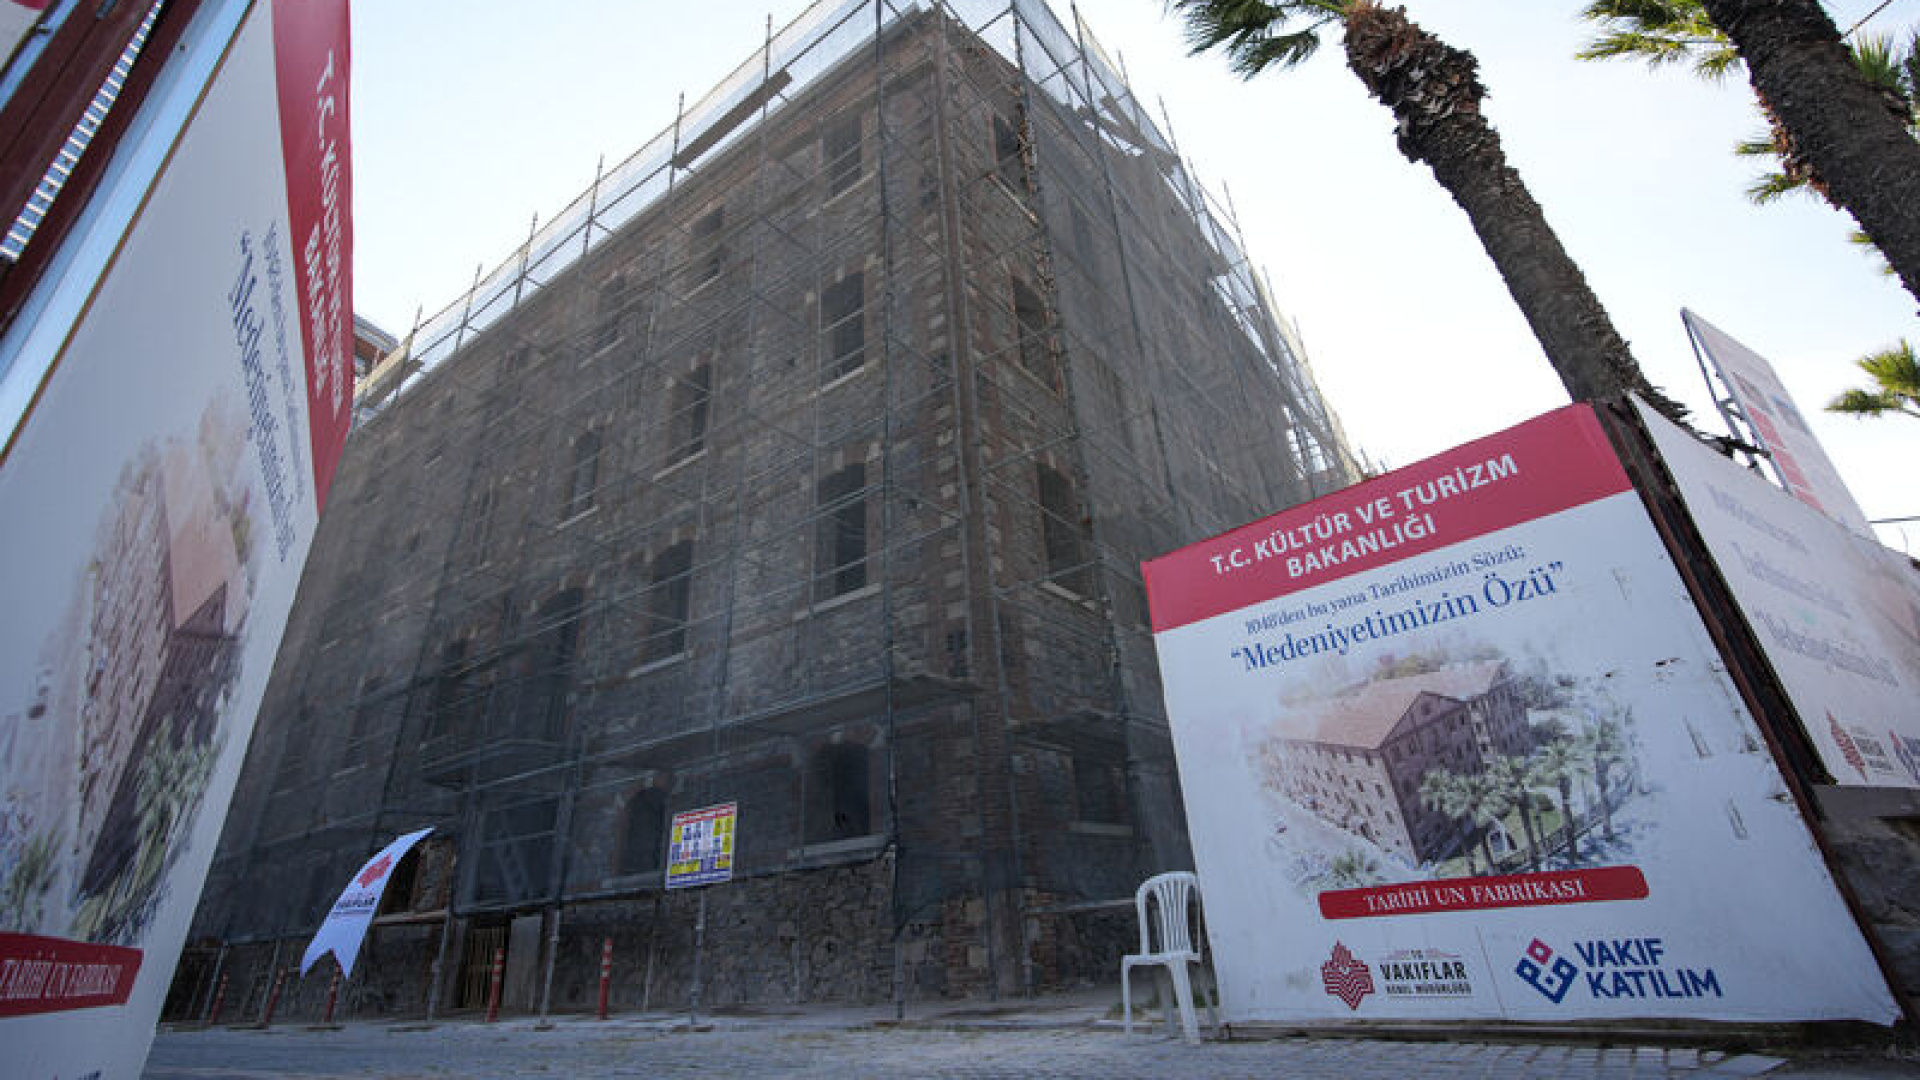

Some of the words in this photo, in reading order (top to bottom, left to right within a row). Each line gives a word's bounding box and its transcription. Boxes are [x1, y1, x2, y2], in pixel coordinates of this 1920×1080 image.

[1209, 548, 1252, 575] T.C.
[1254, 512, 1352, 562] KÜLTÜR
[1355, 496, 1395, 524] VE
[1397, 453, 1518, 510] TURİZM
[1286, 513, 1436, 578] BAKANLIĞI
[1307, 602, 1328, 618] bu
[1329, 592, 1367, 617] yana
[1368, 561, 1471, 600] Tarihimizin
[1230, 591, 1480, 672] “Medeniyetimizin
[1363, 884, 1431, 912] TARİHİ
[1433, 886, 1466, 906] UN
[1469, 877, 1590, 904] FABRİKASI
[1379, 961, 1468, 981] VAKIFLAR
[1573, 938, 1664, 967] VAKIF
[1585, 965, 1724, 998] KATILIM
